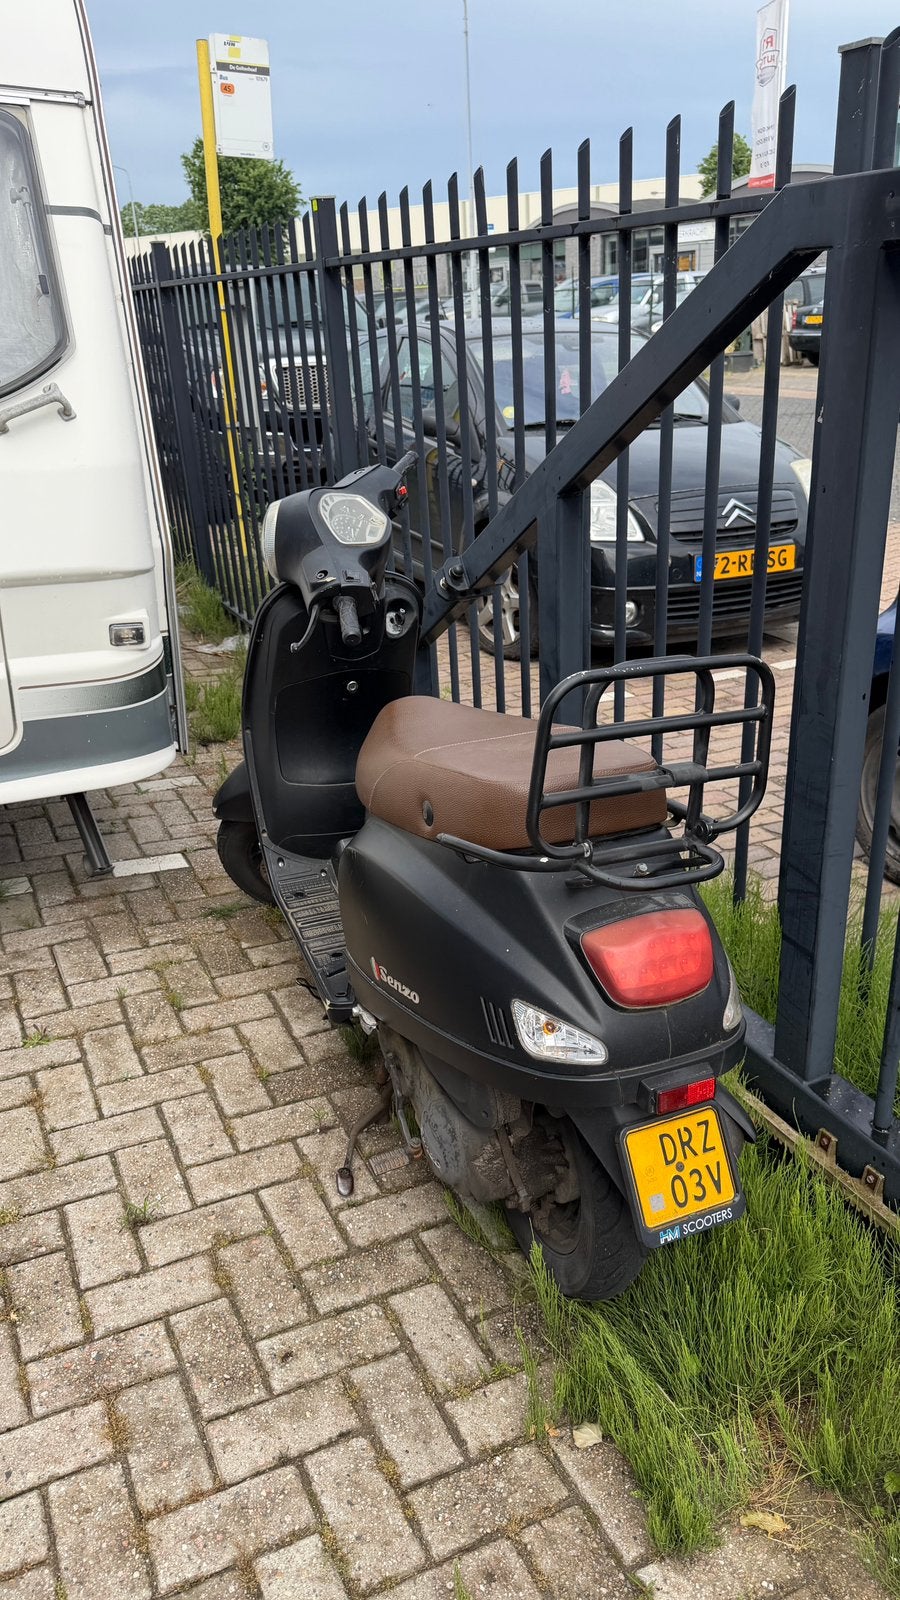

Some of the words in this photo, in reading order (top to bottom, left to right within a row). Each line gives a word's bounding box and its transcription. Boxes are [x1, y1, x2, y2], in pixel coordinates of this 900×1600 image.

[223, 85, 232, 93] 45
[379, 965, 420, 1004] Senzo
[658, 1119, 716, 1166] DRZ
[670, 1161, 722, 1209] 03V
[659, 1225, 681, 1244] HM
[682, 1207, 733, 1235] SCOOTERS
